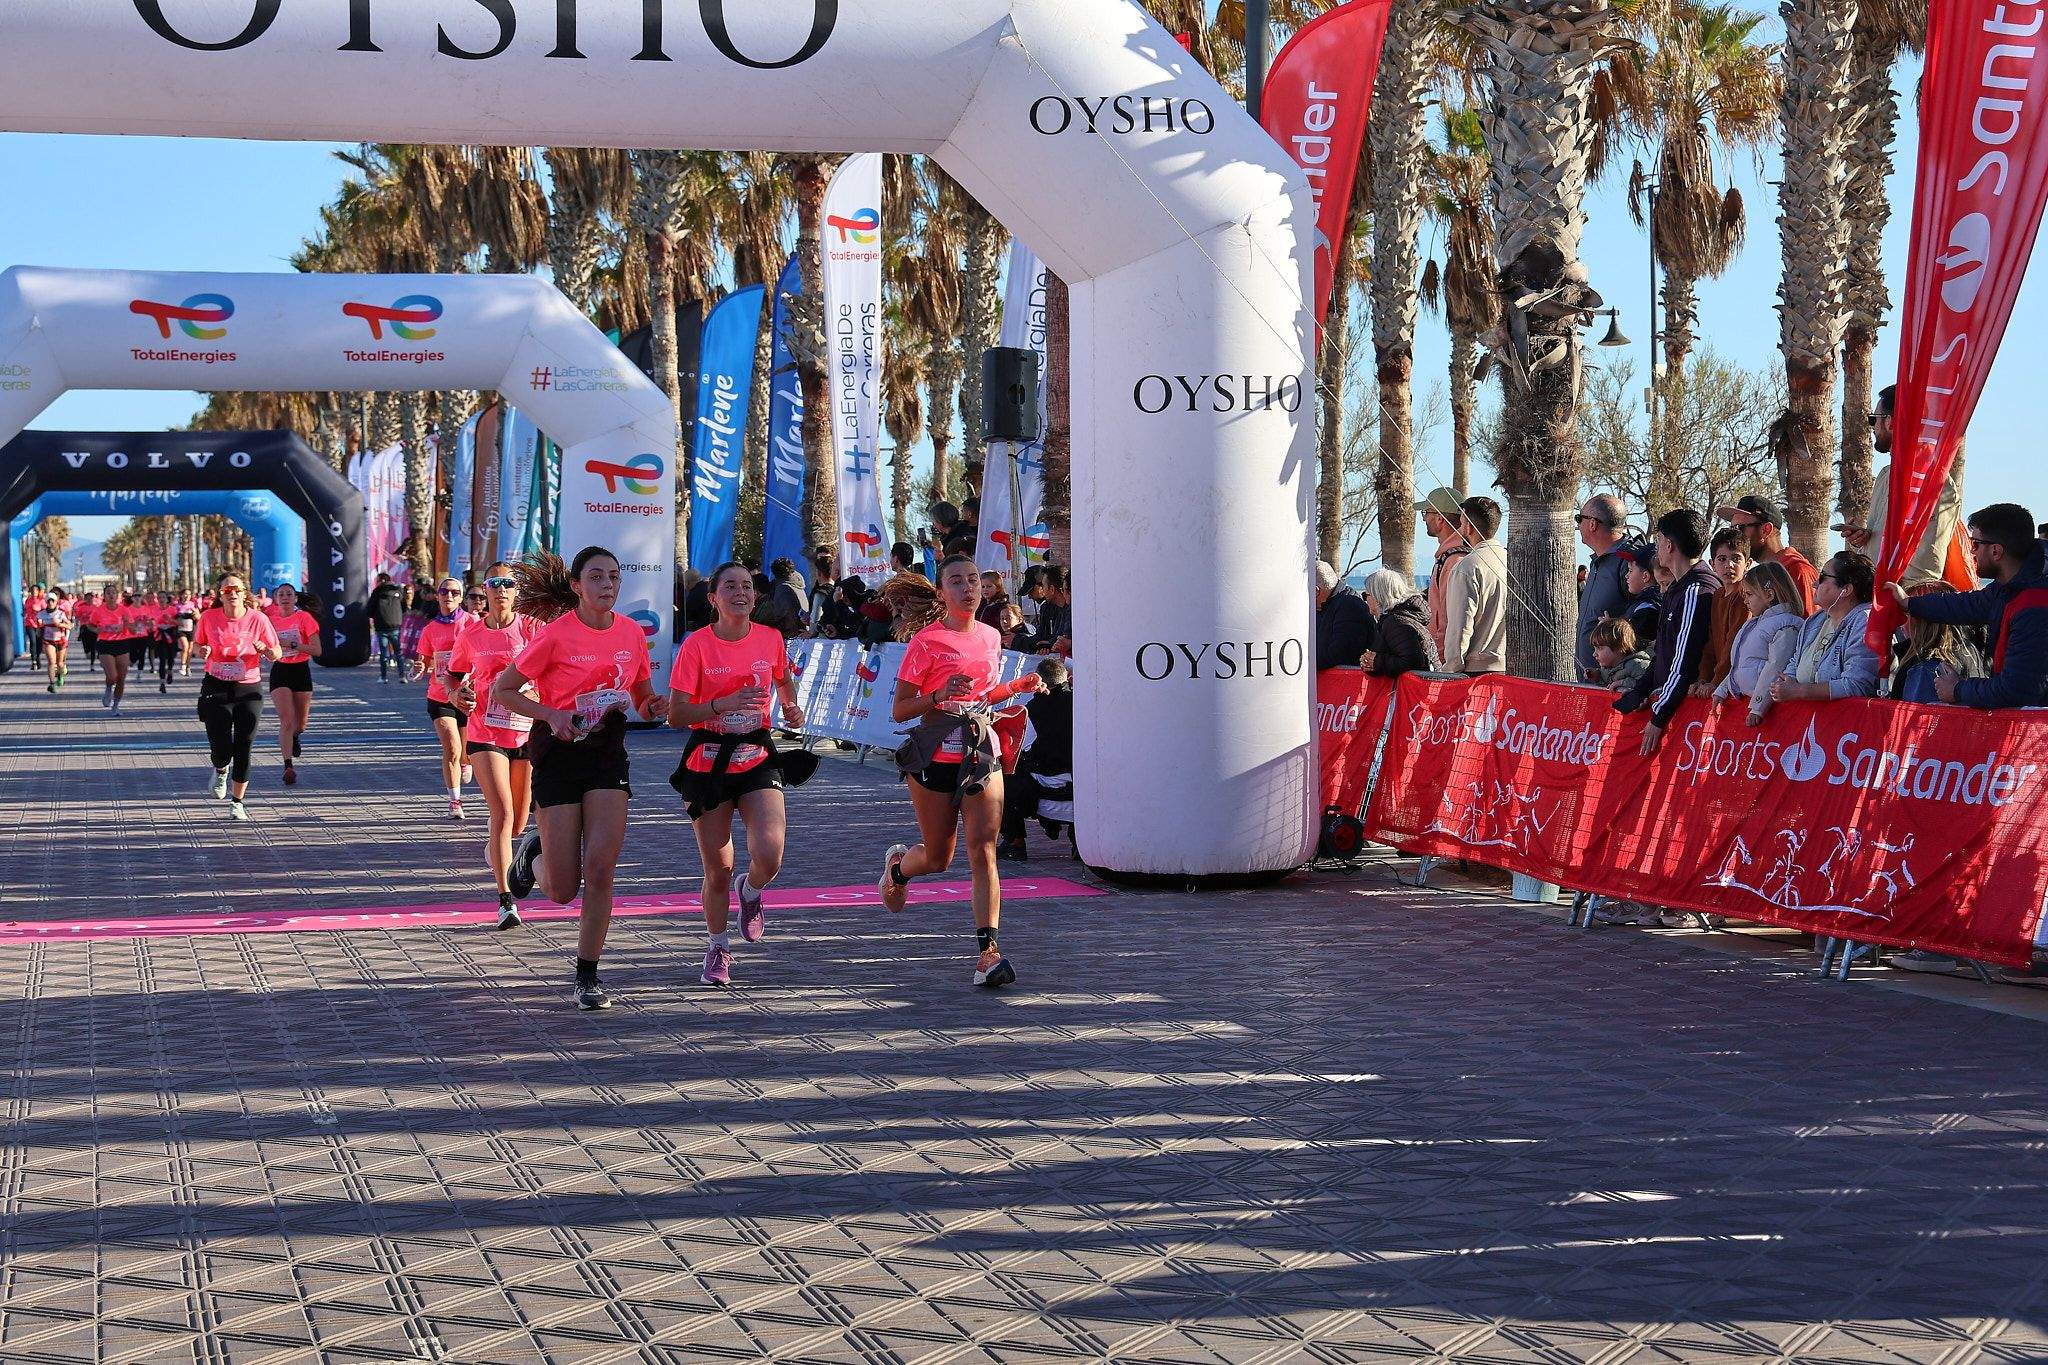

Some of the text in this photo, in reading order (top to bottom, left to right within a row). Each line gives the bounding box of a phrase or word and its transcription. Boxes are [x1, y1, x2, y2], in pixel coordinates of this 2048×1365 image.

[1029, 95, 1215, 135] OYSHO
[130, 349, 236, 364] TotalEnergies
[343, 350, 445, 364] TotalEnergies
[1133, 374, 1303, 413] OYSHO
[694, 374, 739, 503] Marlene
[61, 452, 252, 469] VOLVO
[584, 502, 664, 517] TotalEnergies
[330, 521, 347, 648] VOLVO
[570, 654, 597, 663] OYSHO
[704, 666, 732, 675] OYSHO
[1135, 638, 1303, 681] OYSHO
[1496, 708, 1611, 766] Santander
[1676, 720, 2038, 807] Sports Santander
